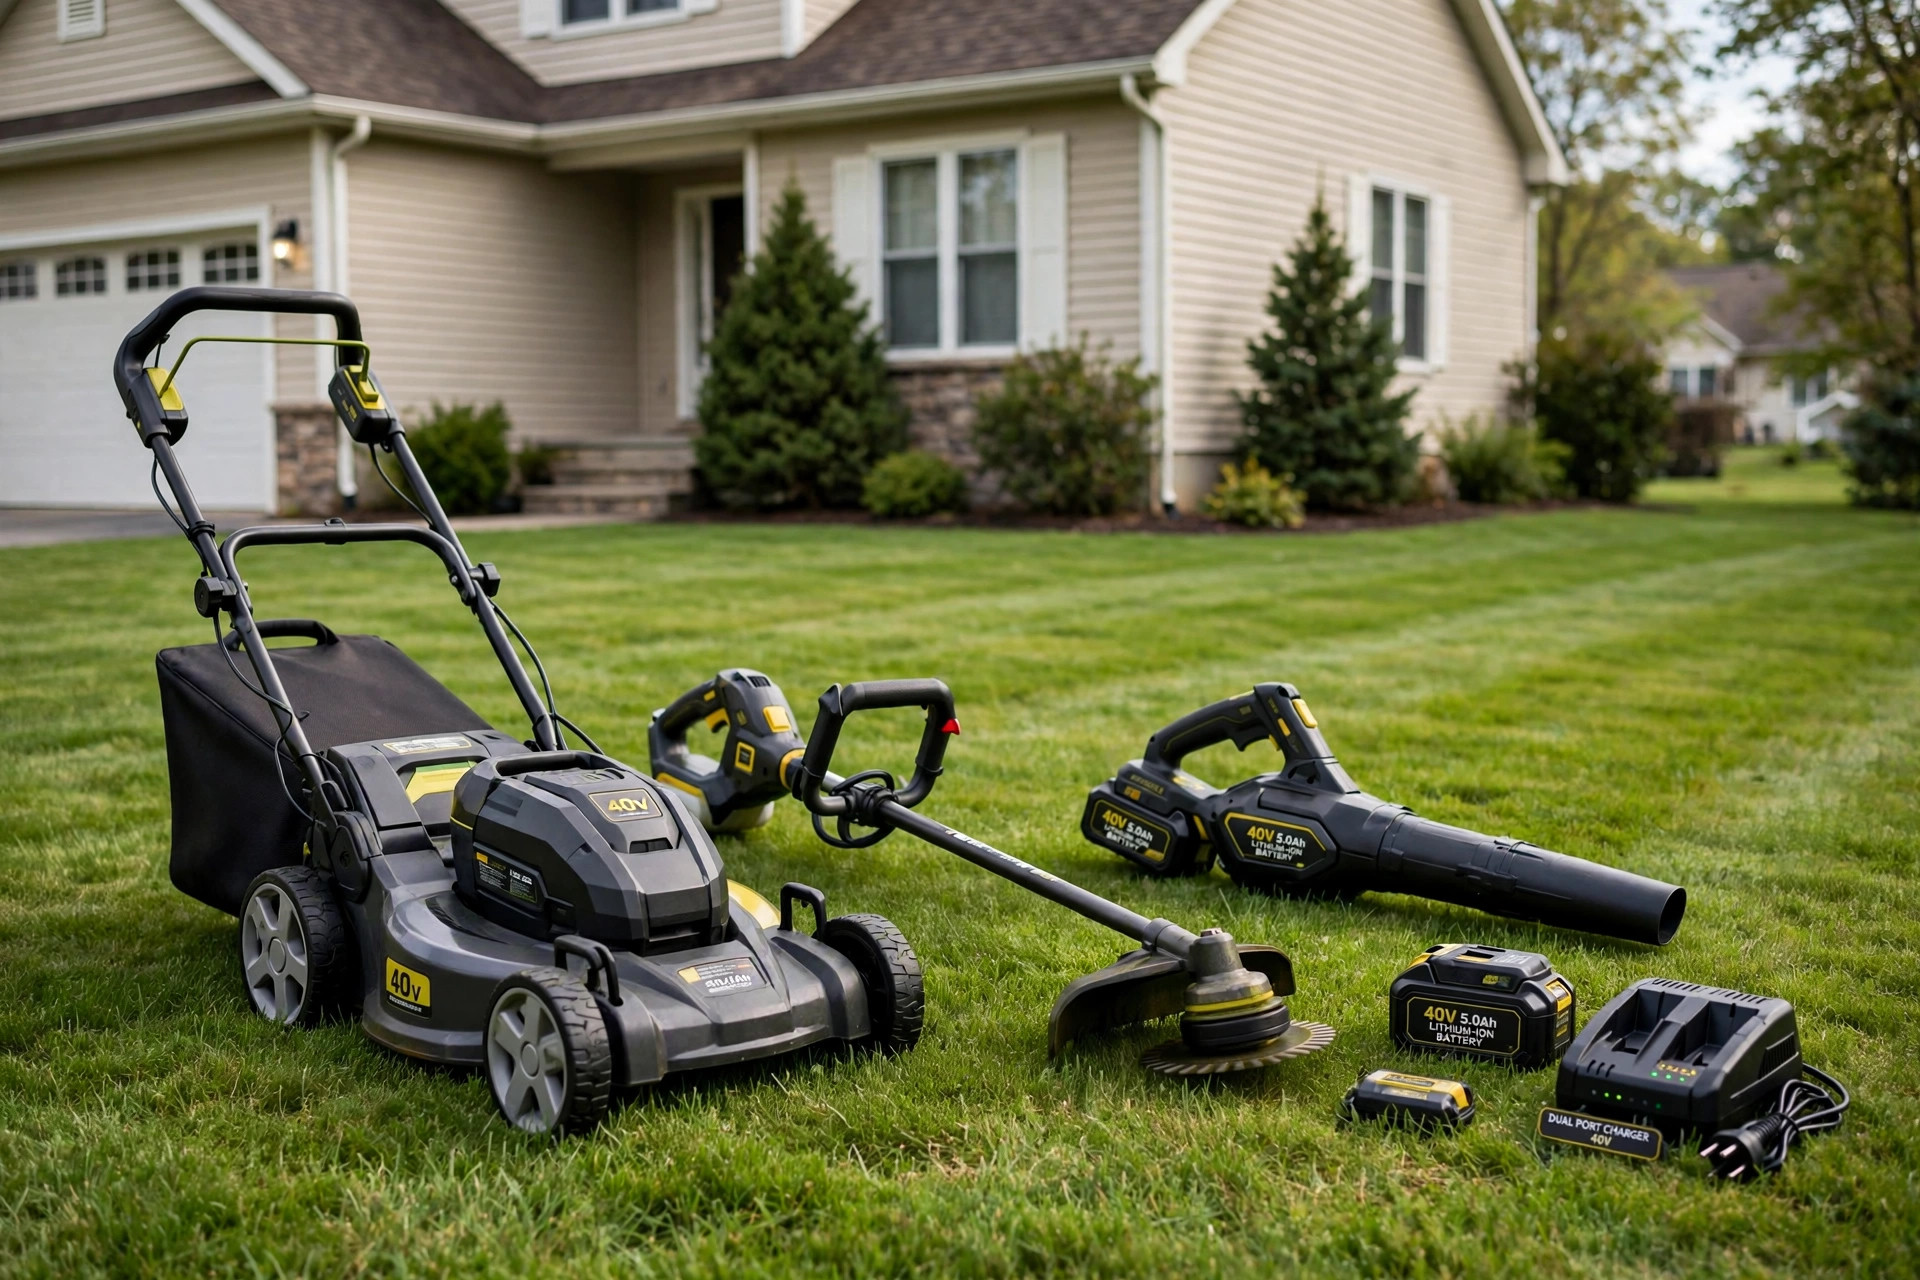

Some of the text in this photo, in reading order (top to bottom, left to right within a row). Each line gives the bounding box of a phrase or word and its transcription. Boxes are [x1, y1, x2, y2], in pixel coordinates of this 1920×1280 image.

[608, 797, 648, 812] 40V
[1102, 809, 1153, 842] 40V 5.0Ah
[1247, 825, 1306, 849] 40V 5.0Ah
[1255, 847, 1294, 862] BATTERY
[1423, 1006, 1497, 1029] 40V 5.0Ah
[1429, 1021, 1495, 1039] LITHIUM-ION
[1436, 1032, 1483, 1047] BATTERY
[1548, 1112, 1650, 1143] DUAL PORT CHARGER
[1590, 1133, 1612, 1147] 40V
